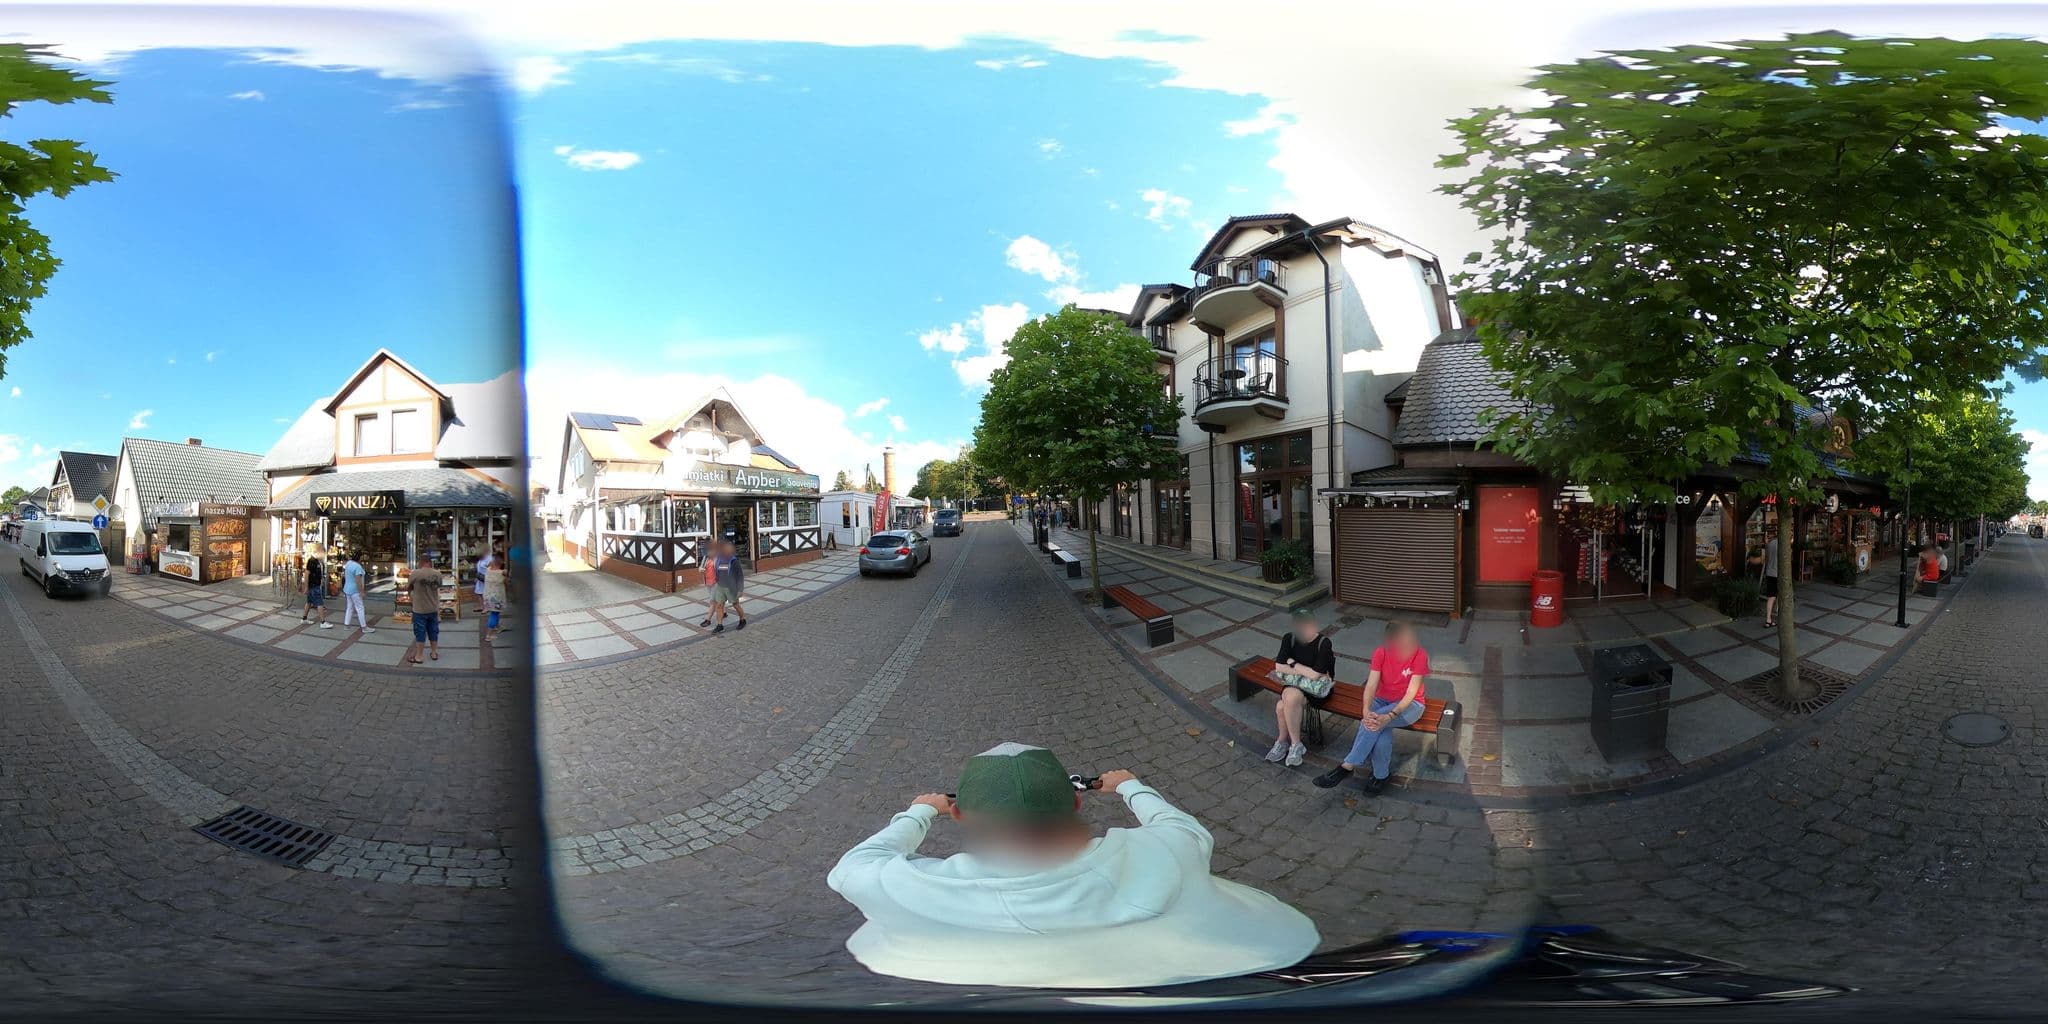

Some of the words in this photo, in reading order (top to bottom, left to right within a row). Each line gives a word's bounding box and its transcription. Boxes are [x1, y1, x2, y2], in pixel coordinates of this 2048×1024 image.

[735, 468, 781, 489] Amber
[333, 495, 397, 509] INKLUZJA
[205, 507, 225, 515] nasze
[226, 506, 247, 516] MENU
